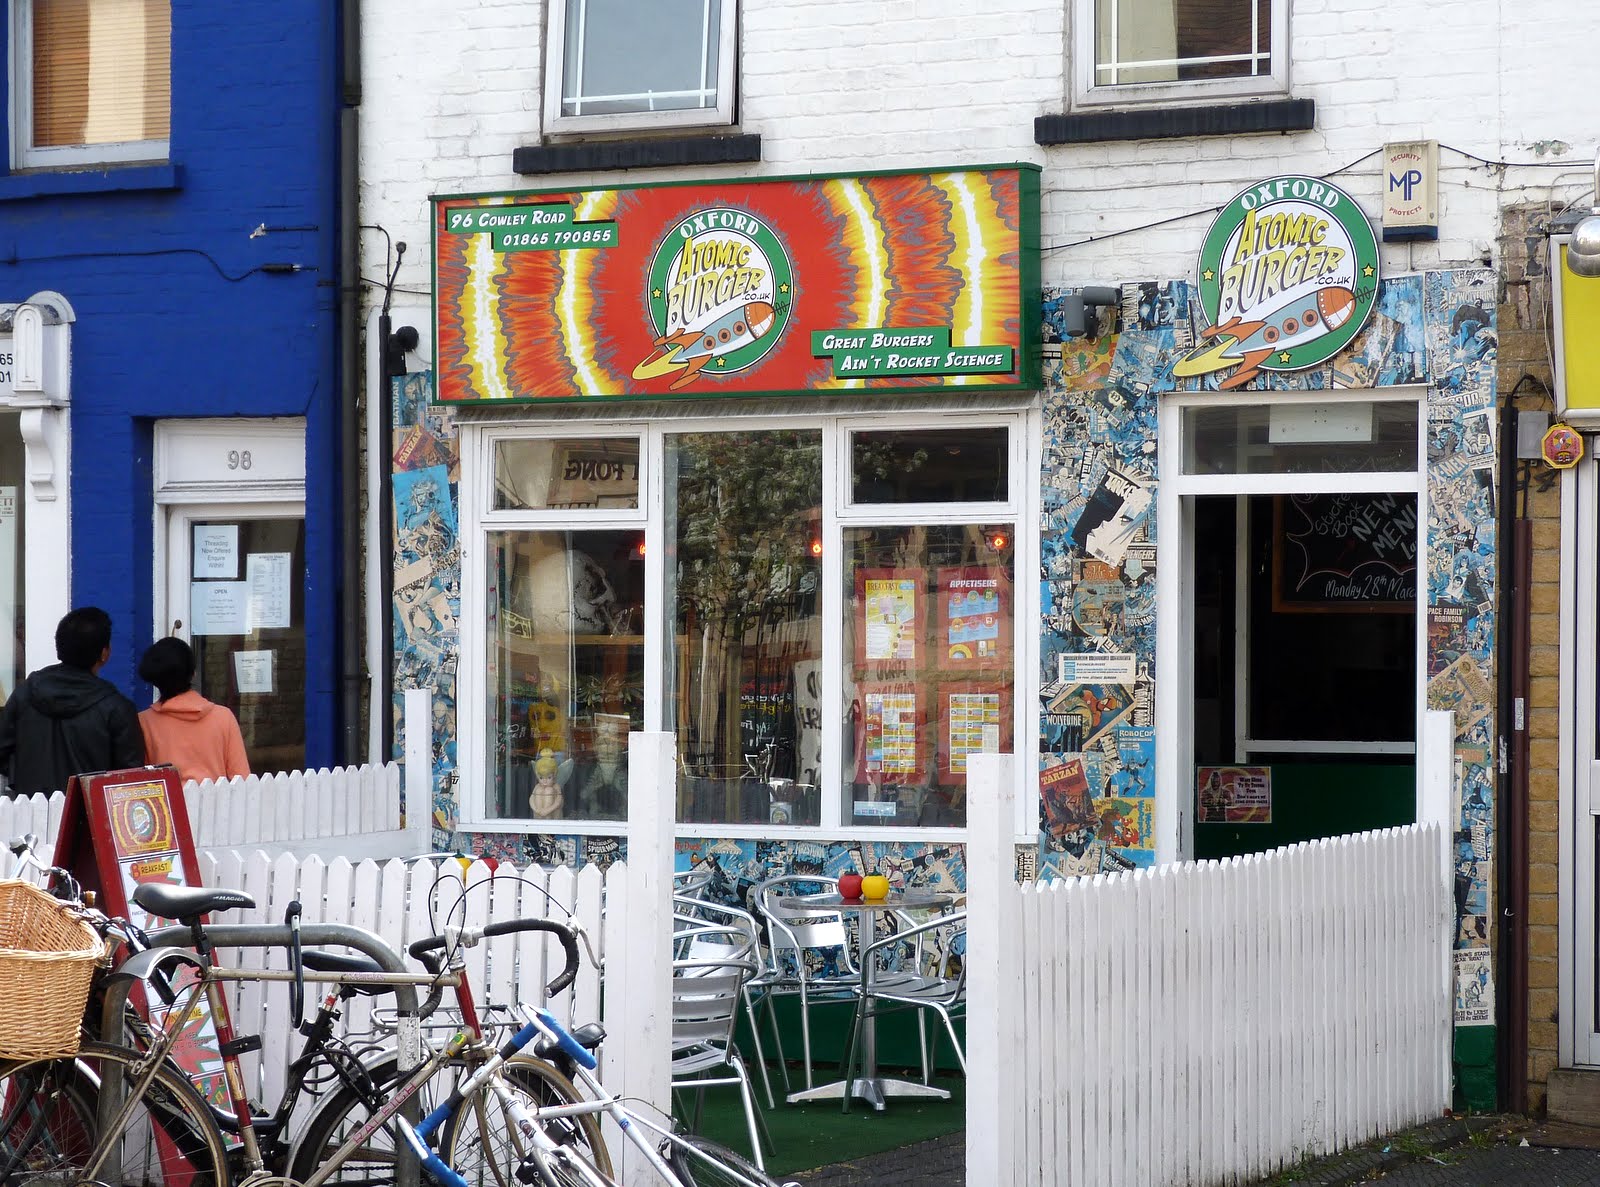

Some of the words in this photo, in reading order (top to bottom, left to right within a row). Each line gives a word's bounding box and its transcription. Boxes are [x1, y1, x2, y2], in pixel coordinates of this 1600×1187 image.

[1390, 153, 1421, 163] SECURITY
[1240, 180, 1339, 210] OXFORD
[1389, 170, 1422, 201] MP
[450, 213, 473, 229] 96
[478, 213, 527, 227] COWLEY
[532, 210, 566, 225] ROAD
[1388, 205, 1422, 217] PROTECTS
[680, 212, 759, 238] OXFORD
[503, 233, 549, 247] 01865
[553, 230, 612, 244] 790855
[1234, 208, 1329, 265] ATOMIC
[676, 237, 753, 285] ATOMIC
[1217, 245, 1345, 328] BURGER
[667, 267, 765, 330] BURGER
[822, 334, 867, 350] GREAT
[870, 333, 934, 348] BURGERS
[886, 353, 941, 369] ROCKET
[944, 352, 1003, 367] SCIENCE
[399, 429, 423, 464] TARZAN
[227, 450, 252, 470] 98
[1315, 493, 1350, 535] Sticke
[1332, 502, 1363, 538] Book
[1352, 493, 1397, 541] NEW
[950, 579, 997, 589] APPETISERS
[1325, 577, 1361, 599] Monday
[1387, 577, 1416, 599] Marc
[1434, 615, 1463, 623] ROBINSON
[1443, 607, 1463, 615] FAMILY
[1046, 714, 1081, 727] WOLVERINE
[1041, 764, 1079, 785] TARZAN
[131, 862, 168, 879] BREAKFAST
[353, 1082, 417, 1143] RALEIGH
